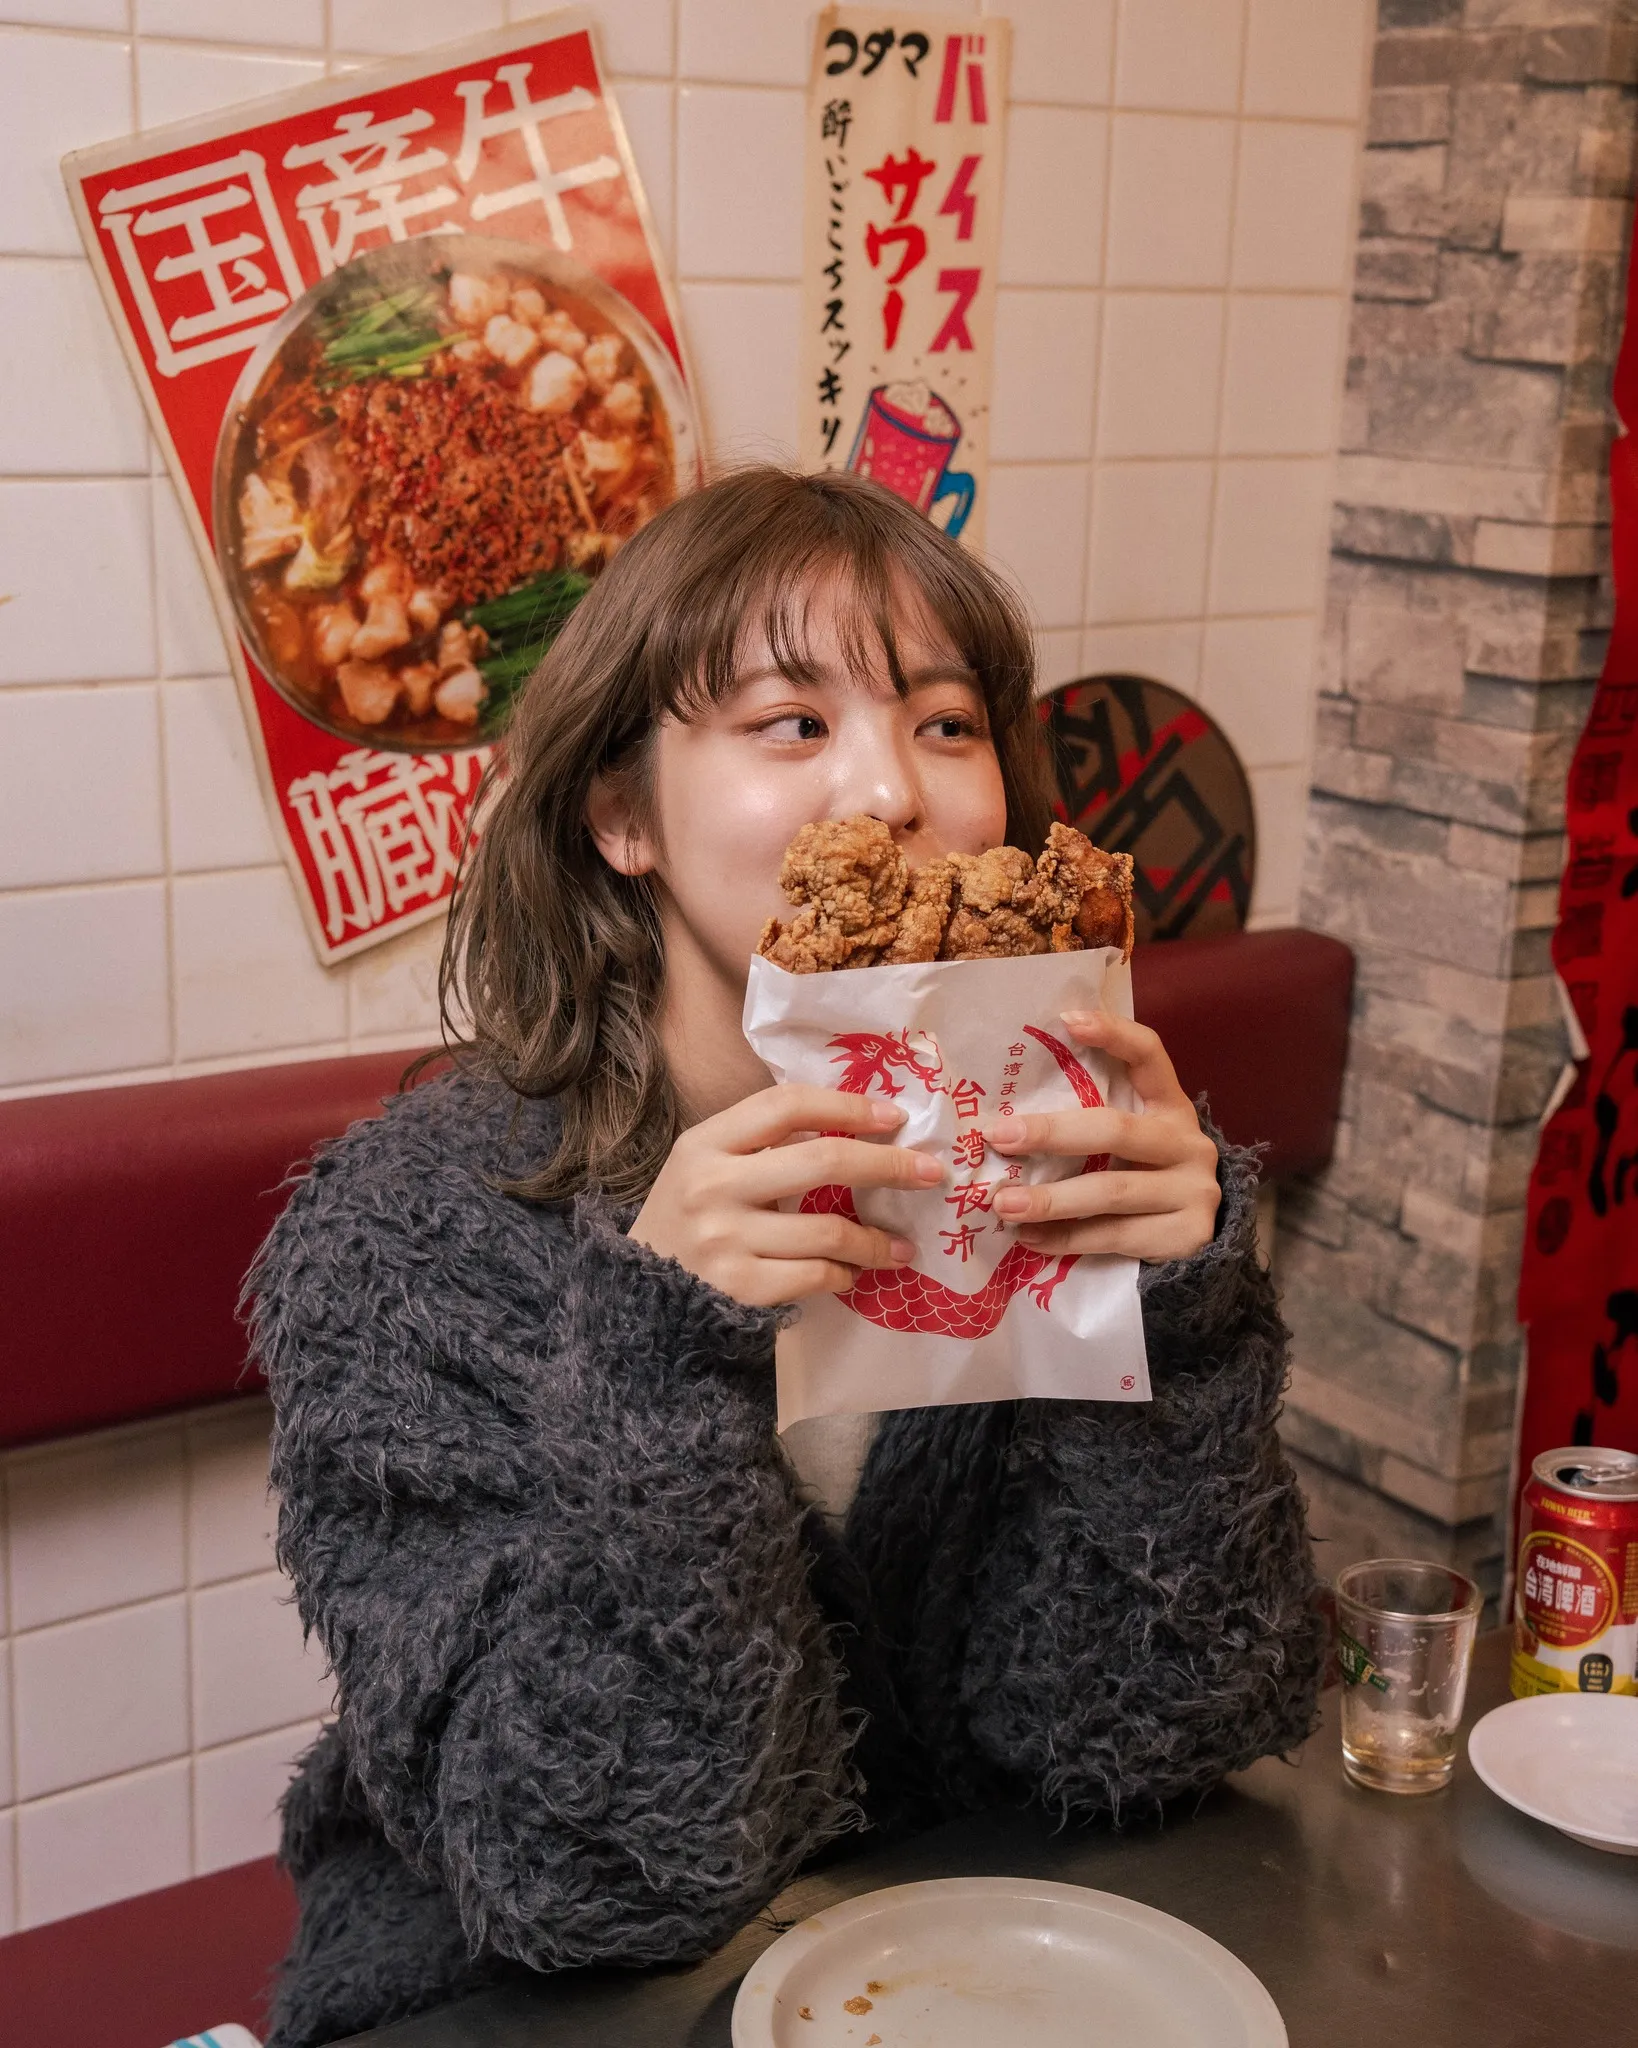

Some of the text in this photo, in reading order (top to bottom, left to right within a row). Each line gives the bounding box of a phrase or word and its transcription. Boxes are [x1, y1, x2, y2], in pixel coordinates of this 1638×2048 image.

[825, 27, 930, 77] コダマ
[99, 62, 621, 377] 国産牛
[864, 146, 937, 352] サワー
[928, 34, 988, 353] バイス
[938, 1078, 993, 1263] 台湾夜市
